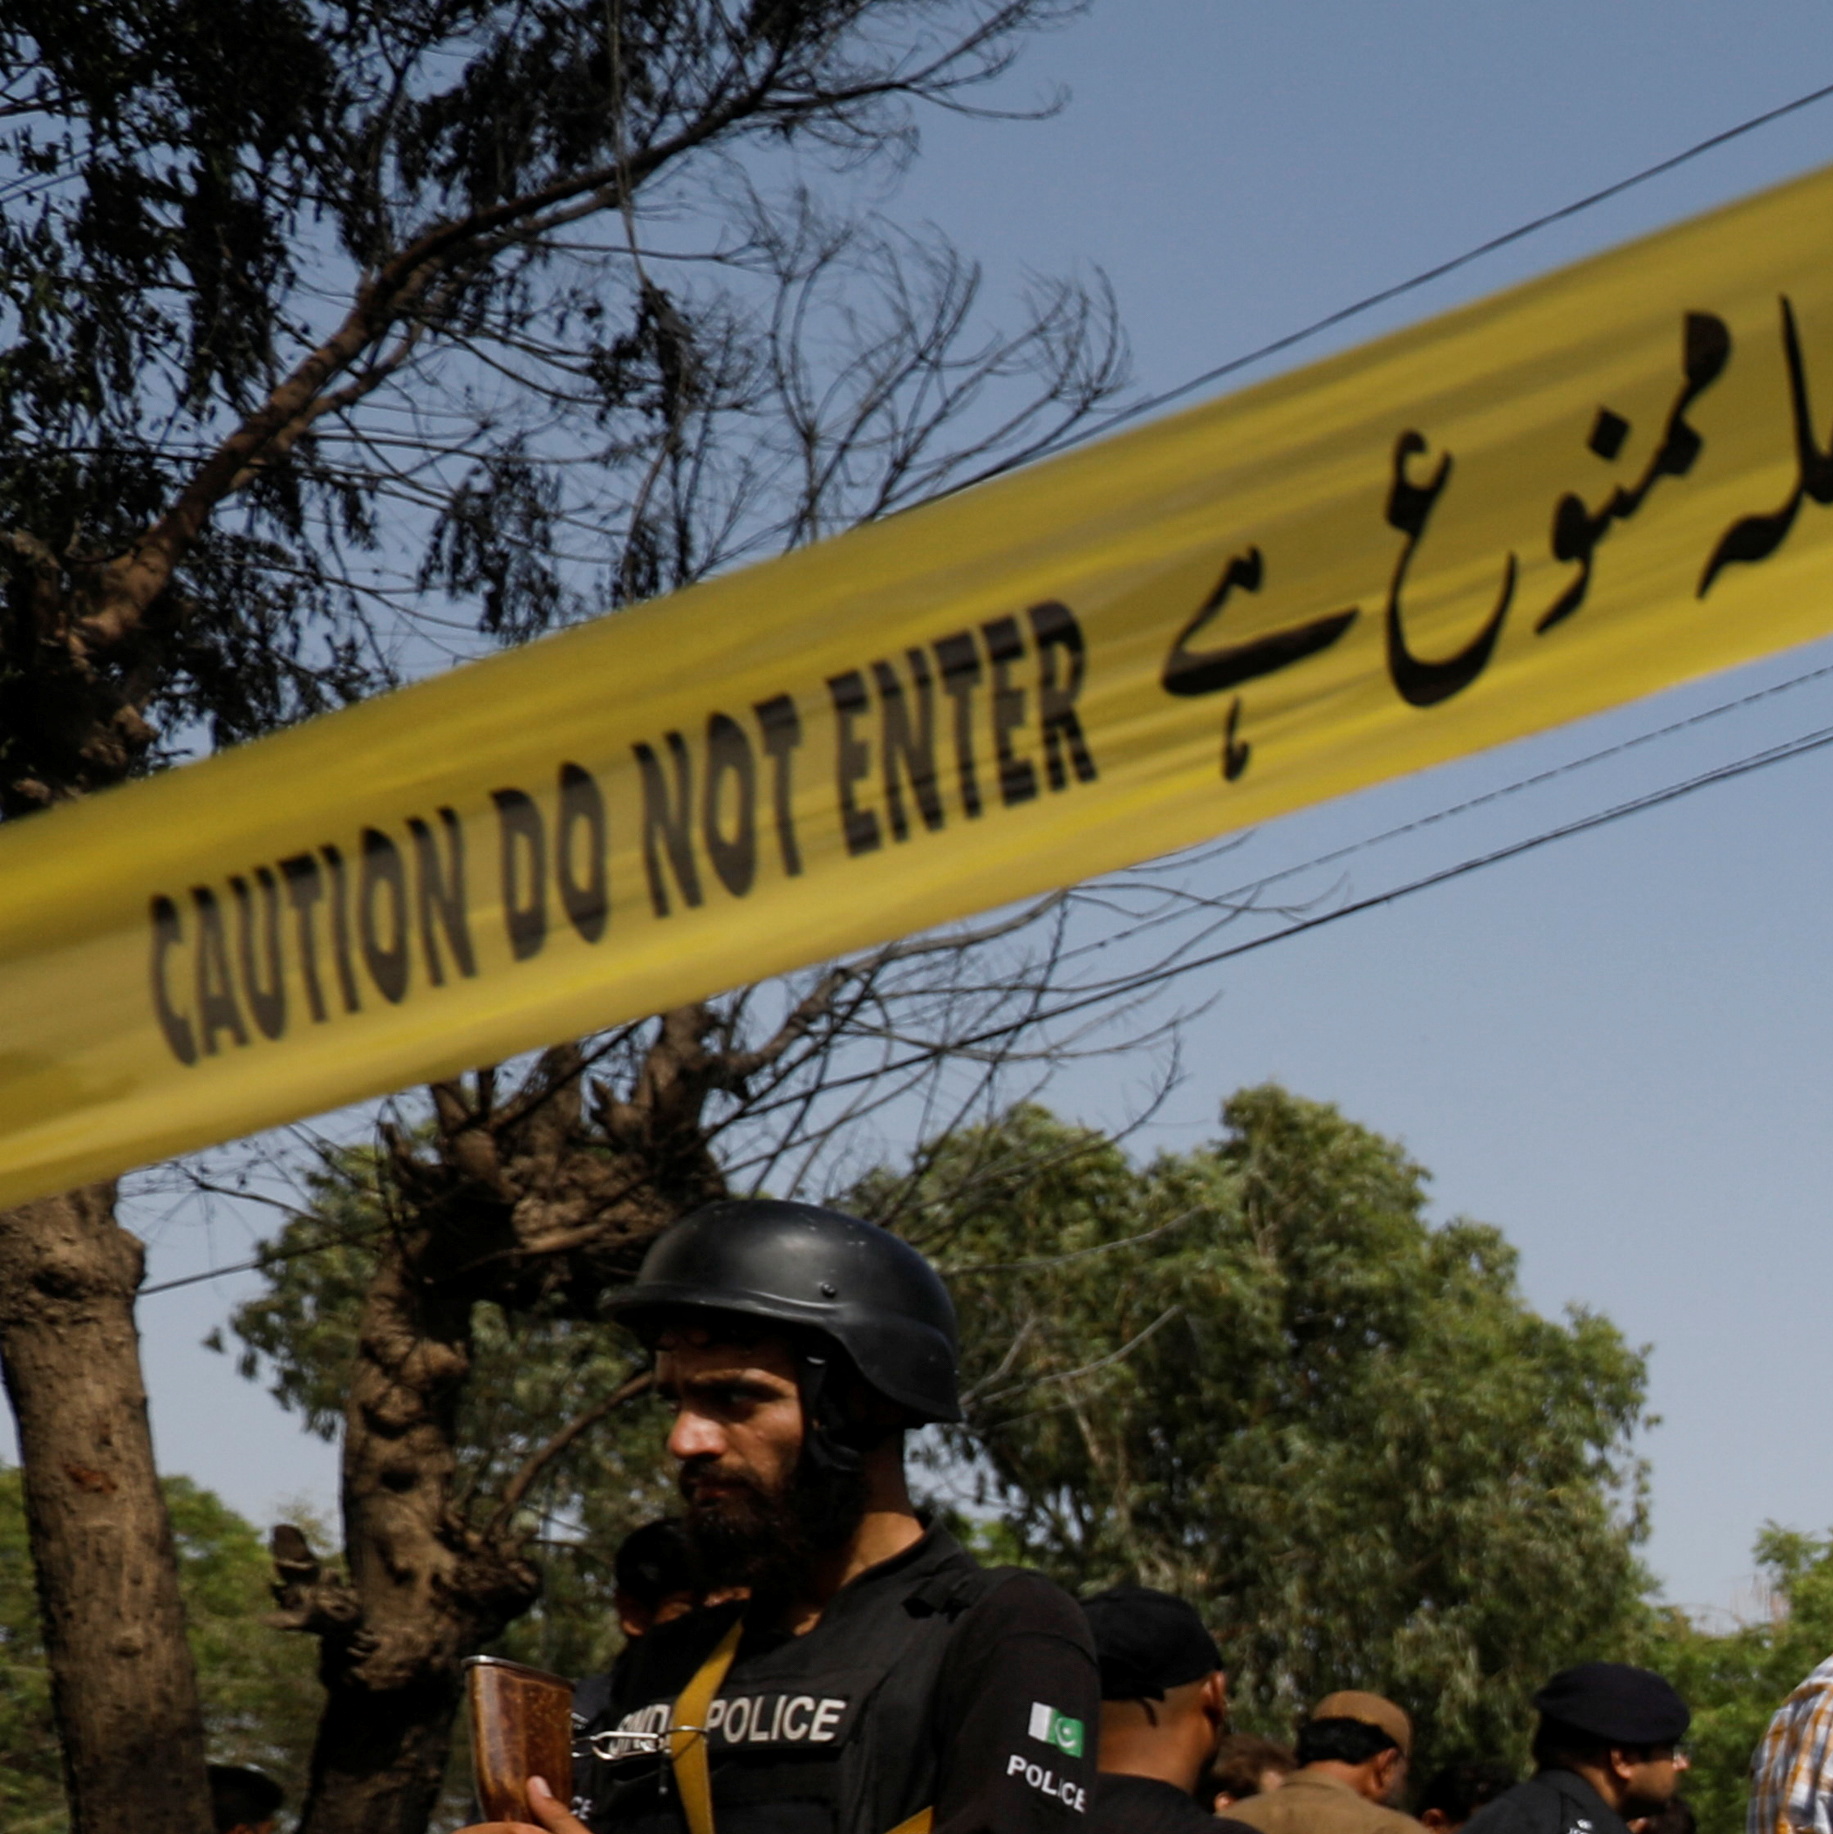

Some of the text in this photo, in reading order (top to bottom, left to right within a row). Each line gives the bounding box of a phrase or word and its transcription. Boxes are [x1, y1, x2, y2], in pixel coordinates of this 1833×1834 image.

[1385, 312, 1733, 708] ممنوع
[1161, 546, 1359, 781] ہے
[149, 600, 1099, 1067] CAUTION DO NOT ENTER
[706, 1694, 847, 1744] POLICE
[1007, 1754, 1086, 1813] POLICE
